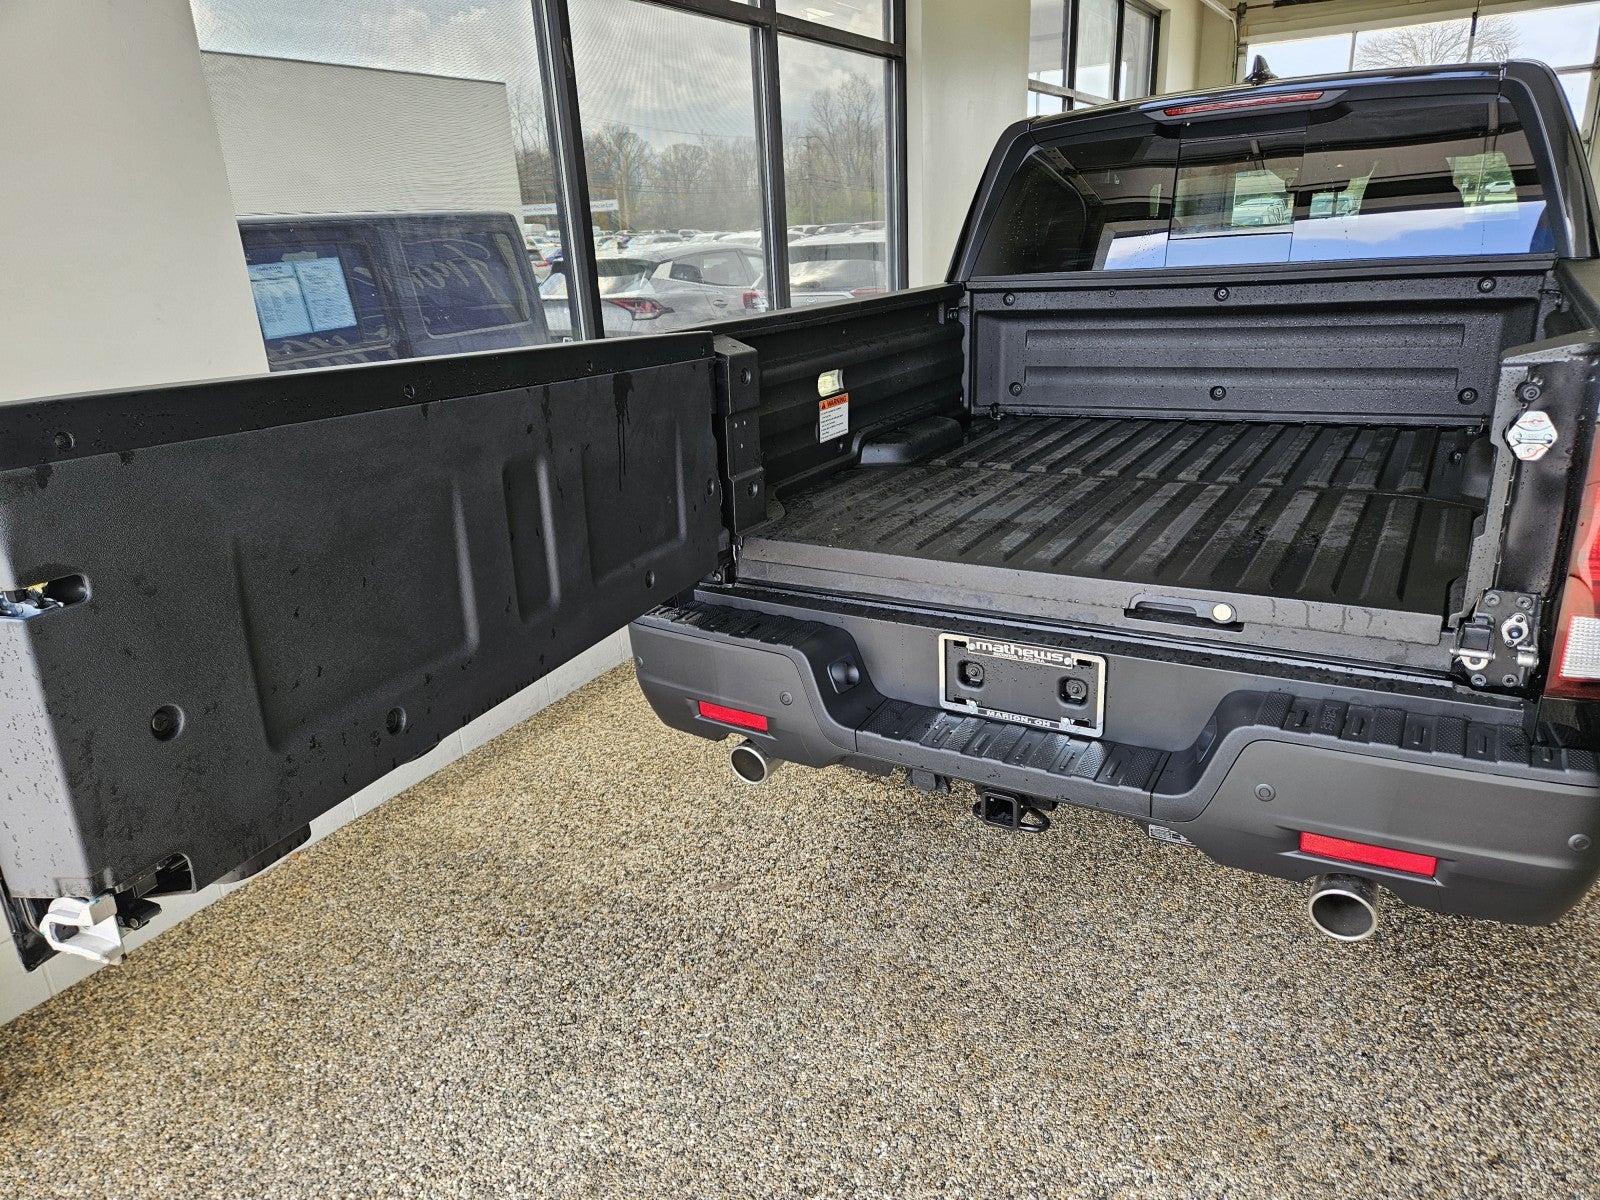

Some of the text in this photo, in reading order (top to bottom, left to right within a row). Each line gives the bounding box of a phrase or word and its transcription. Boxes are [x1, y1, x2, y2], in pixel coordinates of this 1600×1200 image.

[976, 641, 1063, 663] mathews
[993, 651, 1045, 664] HONDA ACURA
[986, 710, 1050, 727] MARION, OH
